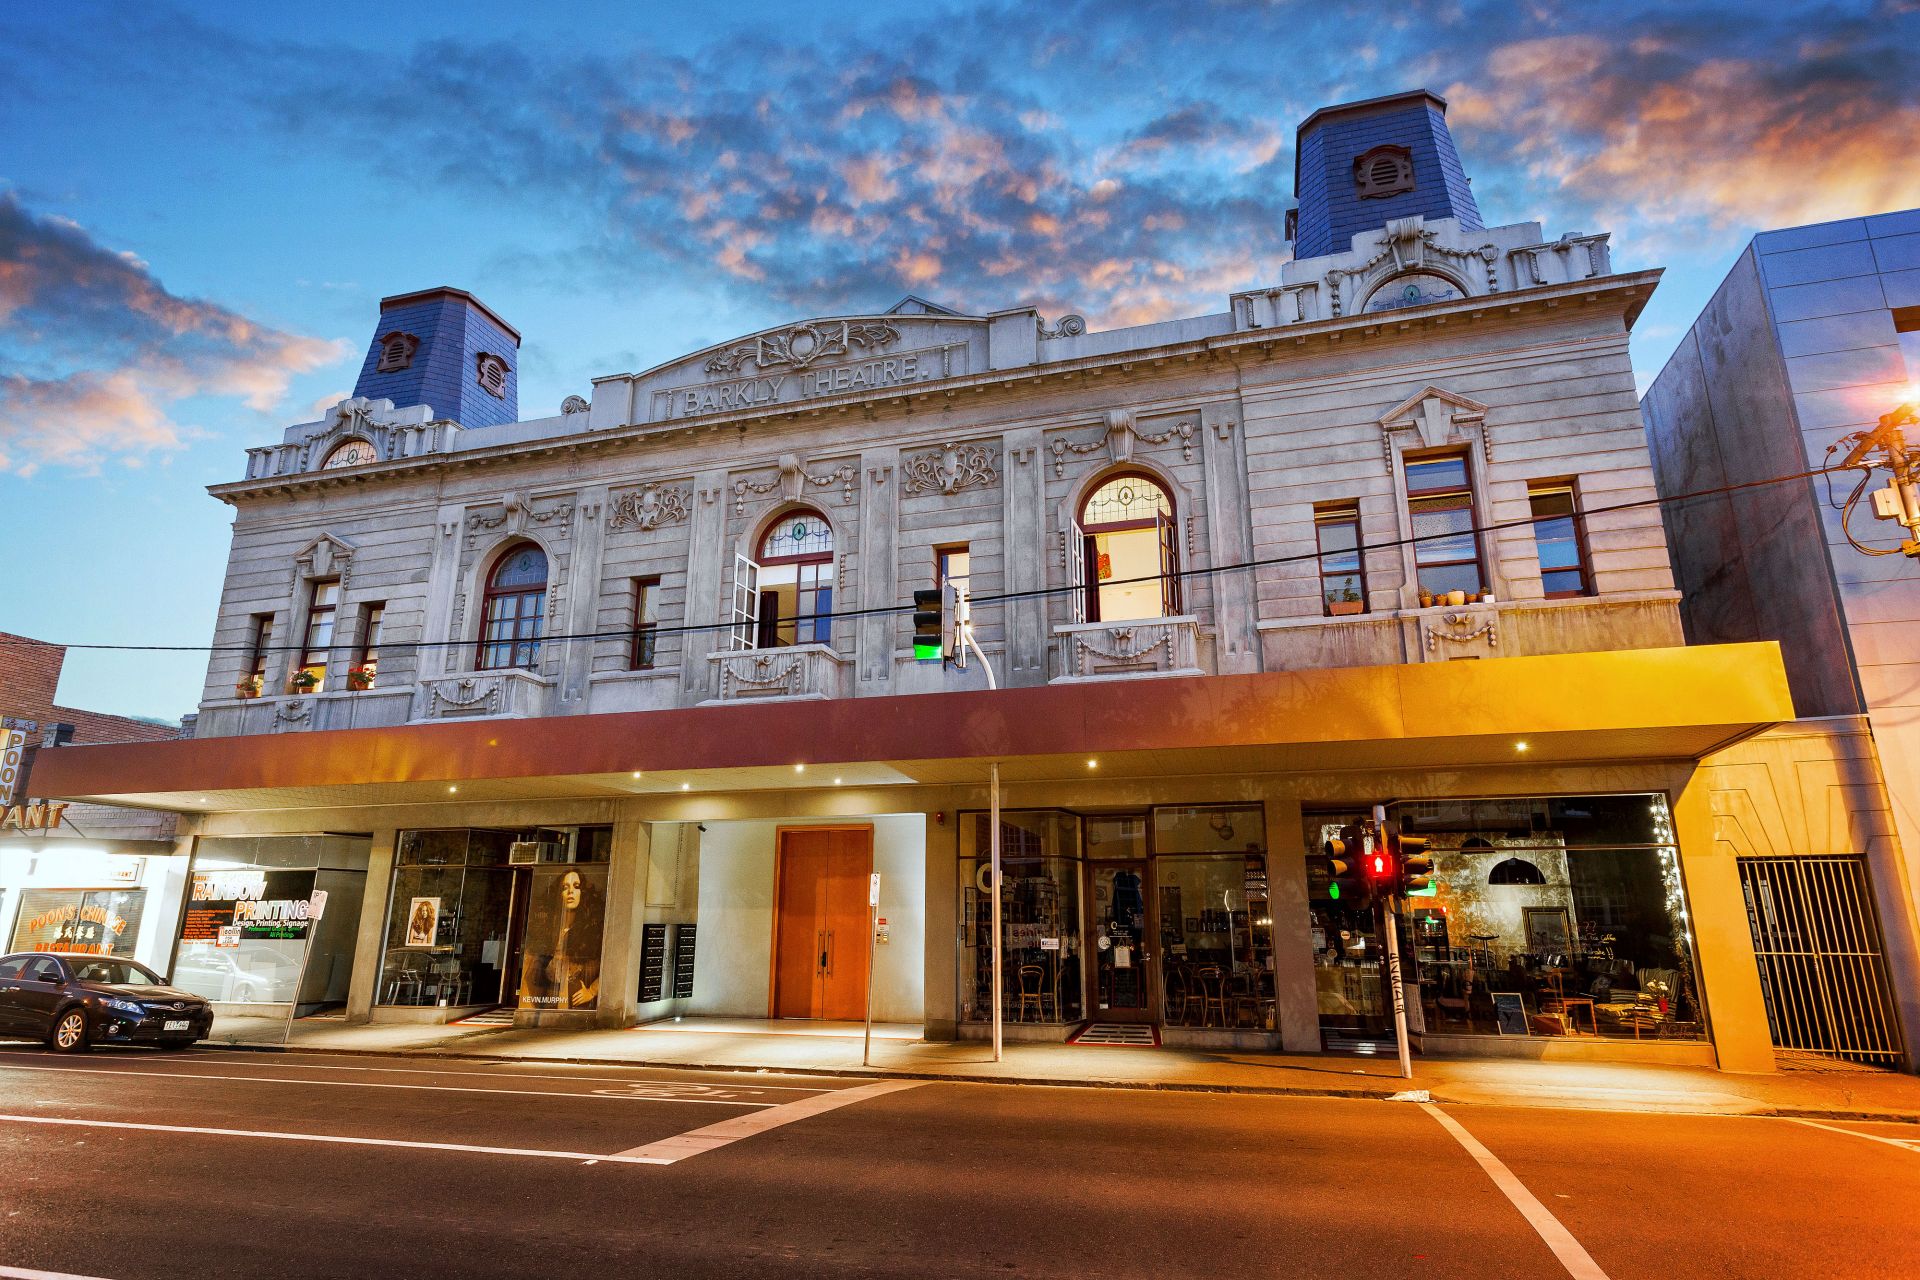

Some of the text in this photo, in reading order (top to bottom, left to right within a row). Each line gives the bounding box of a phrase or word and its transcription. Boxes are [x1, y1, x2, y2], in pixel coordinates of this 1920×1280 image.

[683, 376, 785, 414] BARKLY
[192, 881, 268, 901] RAINBOW
[29, 904, 77, 934] POON'S
[233, 900, 309, 920] PRINTING
[282, 920, 308, 929] Signage
